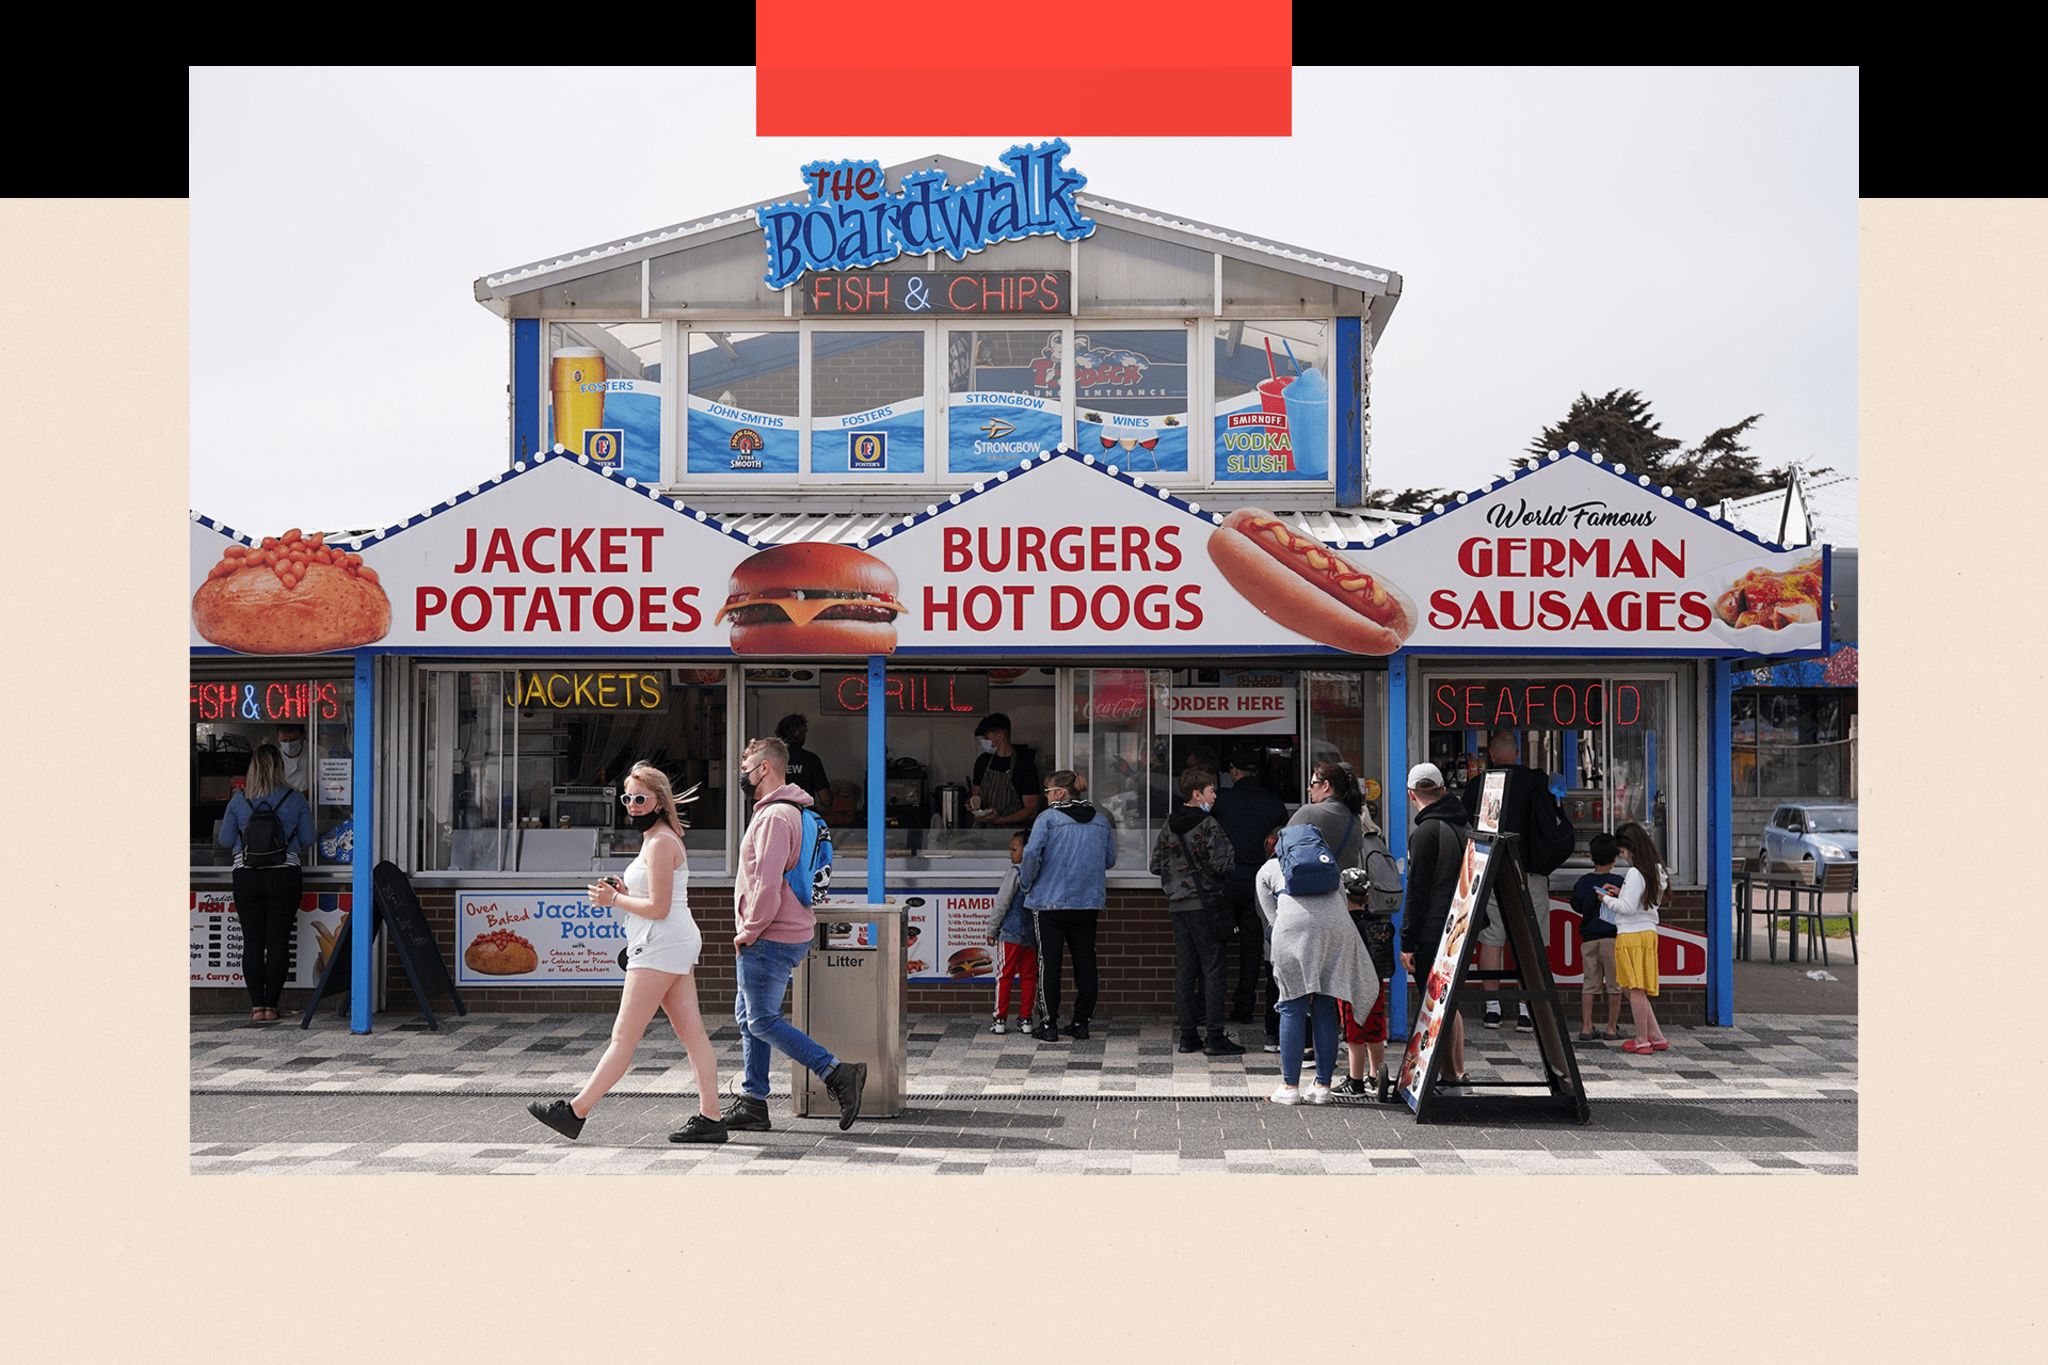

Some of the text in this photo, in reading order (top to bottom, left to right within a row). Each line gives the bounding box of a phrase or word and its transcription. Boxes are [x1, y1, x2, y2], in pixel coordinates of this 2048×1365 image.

[814, 275, 1060, 311] FISH & CHIPS
[580, 381, 634, 394] FOSTERS
[1084, 388, 1167, 397] ENTRANCE
[966, 393, 1045, 409] STRONGBOW
[707, 404, 784, 428] JOHN SMITHS
[842, 406, 894, 427] FOSTERS
[1113, 416, 1150, 428] WINES
[1233, 415, 1282, 425] SMIRNOFF
[974, 440, 1041, 455] STRONGBOW
[1223, 432, 1292, 451] VODKA
[730, 460, 762, 469] SMOOTH
[1227, 454, 1288, 473] SLUSH
[1486, 498, 1657, 530] World Famous
[454, 528, 664, 575] JACKET
[943, 526, 1183, 572] BURGERS
[1457, 536, 1685, 578] GERMAN
[415, 586, 702, 633] POTATOES
[923, 584, 1204, 631] HOT DOGS
[1428, 589, 1713, 632] SAUSAGES
[507, 672, 661, 709] JACKETS
[837, 675, 974, 711] GRILL
[242, 684, 260, 720] &
[266, 683, 337, 719] CHIPS
[1082, 697, 1143, 719] Cca-Cola
[1168, 696, 1285, 711] ORDER HERE
[1435, 684, 1641, 726] SEAFOOD
[198, 903, 224, 913] FISH
[466, 902, 498, 916] Oven
[486, 908, 530, 928] Baked
[550, 949, 575, 957] Cheese
[827, 955, 864, 967] Litter
[207, 973, 230, 982] Curry
